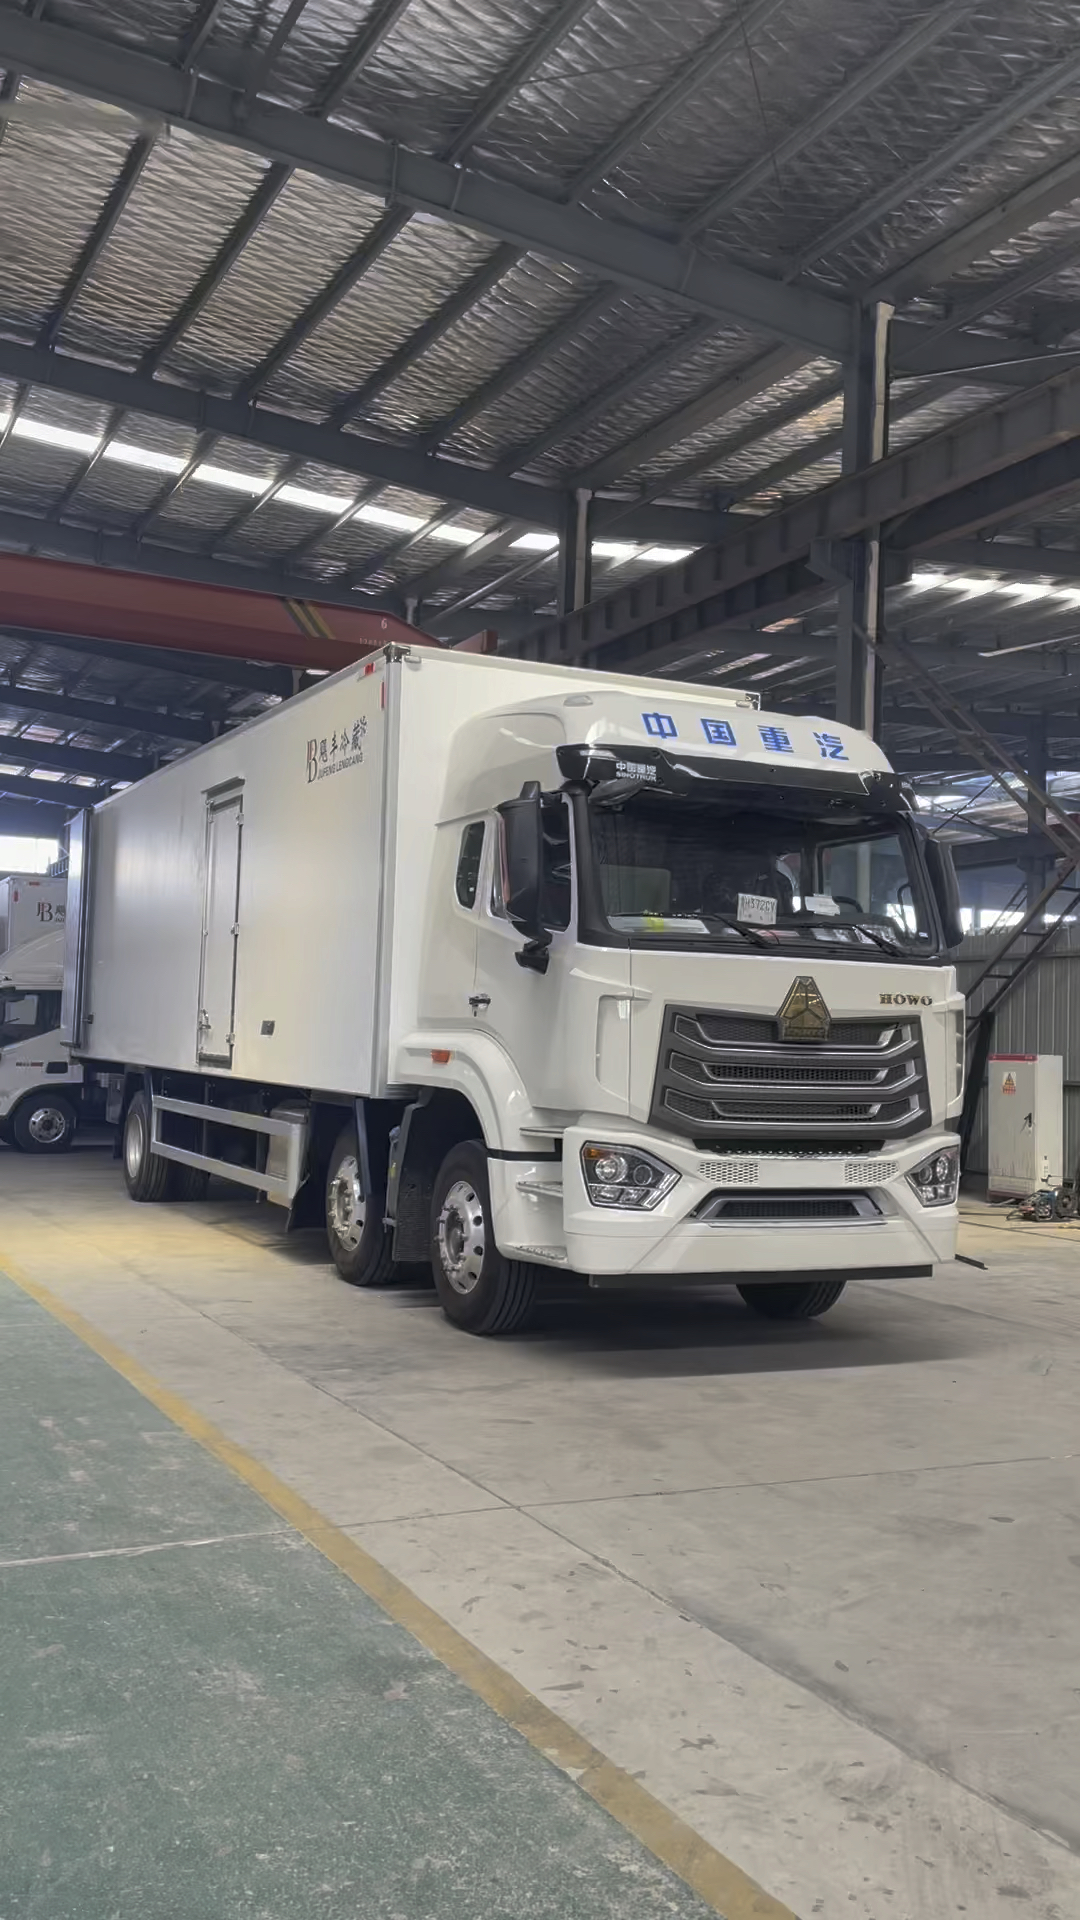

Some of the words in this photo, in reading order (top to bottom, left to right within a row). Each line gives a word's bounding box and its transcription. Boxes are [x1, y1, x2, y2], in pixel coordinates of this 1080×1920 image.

[641, 712, 850, 761] 中国重汽
[615, 770, 657, 782] SINOTRUK
[879, 993, 934, 1007] HOWO
